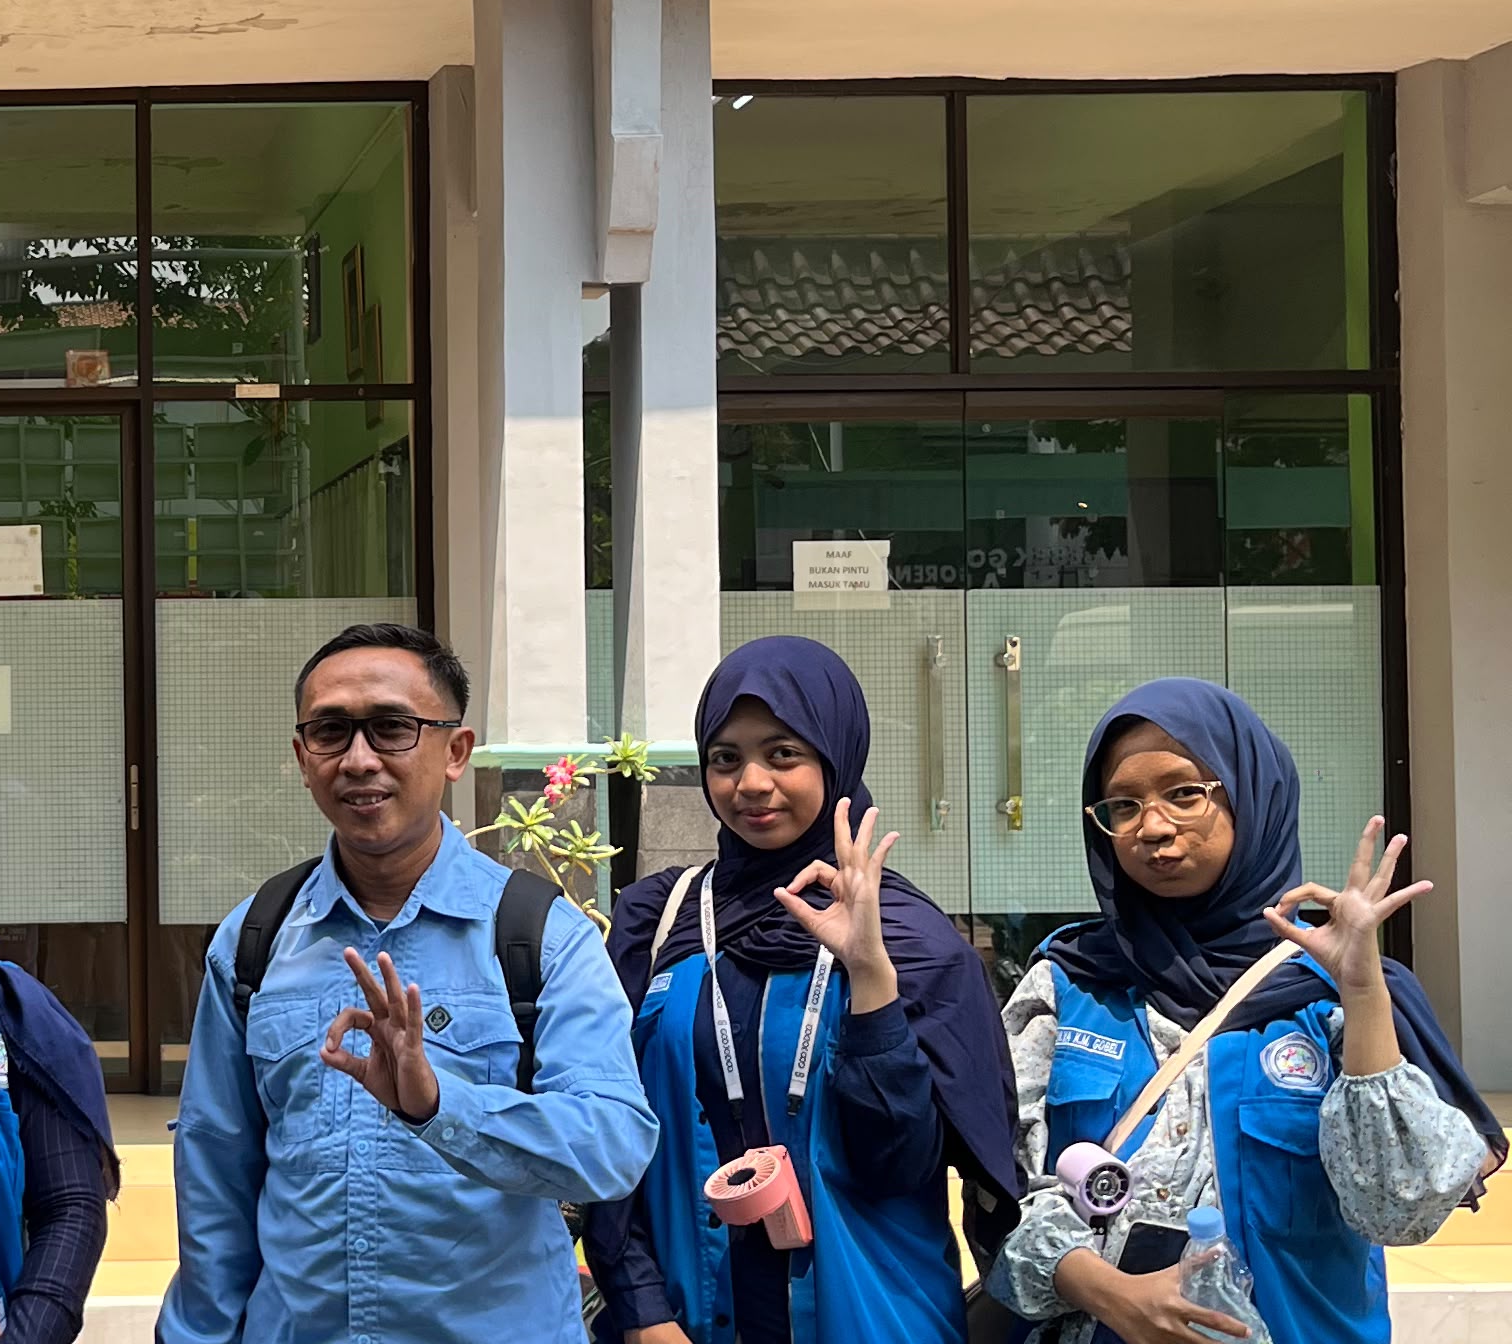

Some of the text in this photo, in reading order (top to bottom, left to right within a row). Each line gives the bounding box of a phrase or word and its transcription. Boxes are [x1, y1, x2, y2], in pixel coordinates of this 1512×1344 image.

[826, 551, 852, 559] MAAF
[809, 566, 869, 575] BUKAN PINTU
[808, 580, 870, 589] MASUK TAMU
